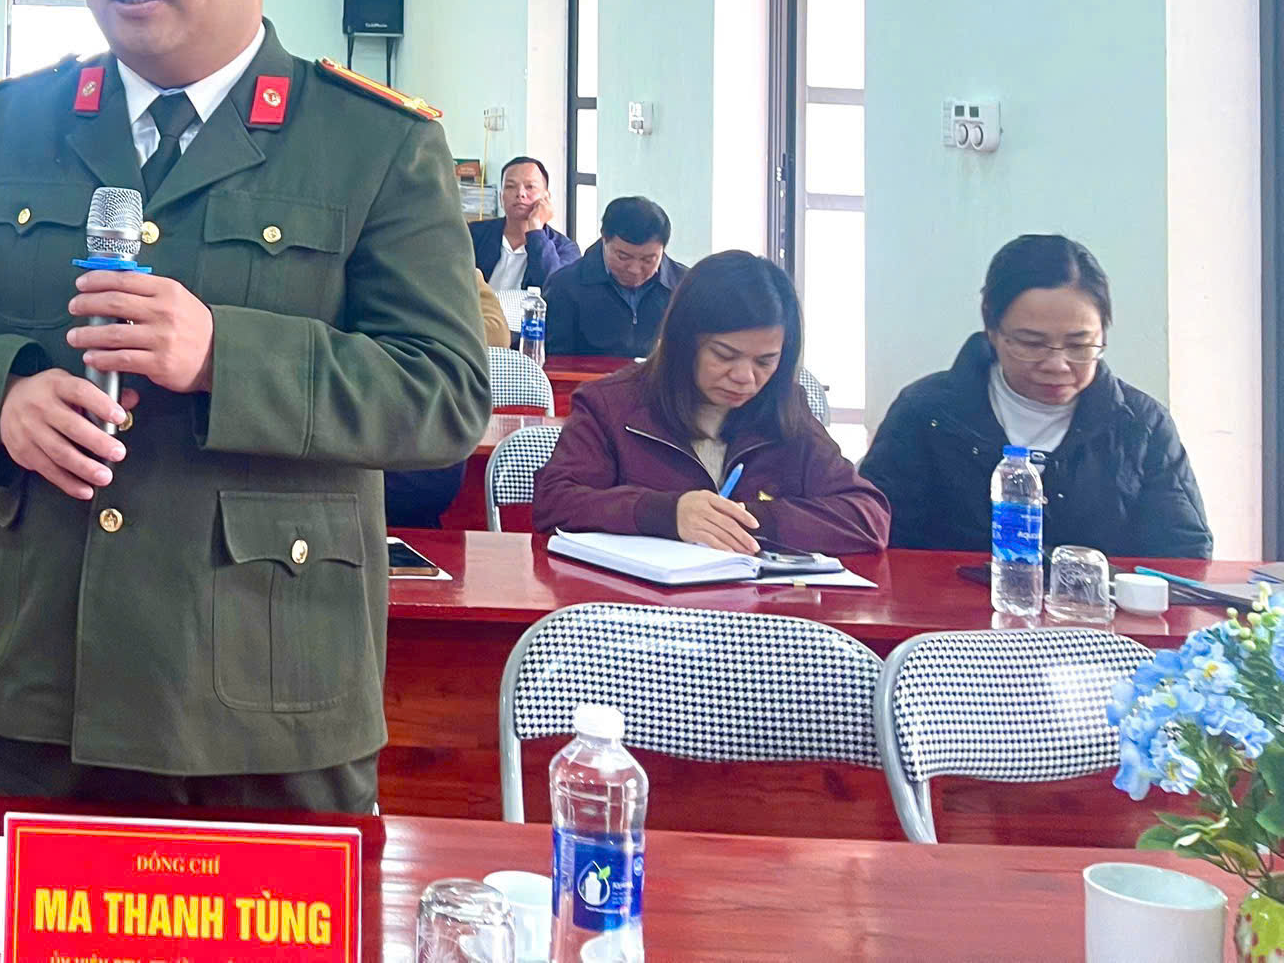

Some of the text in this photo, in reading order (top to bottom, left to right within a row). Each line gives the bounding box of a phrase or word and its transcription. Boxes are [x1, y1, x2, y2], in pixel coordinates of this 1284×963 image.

[136, 850, 221, 875] ĐỒNG CHÍ
[34, 887, 333, 946] MA THANH TÙNG
